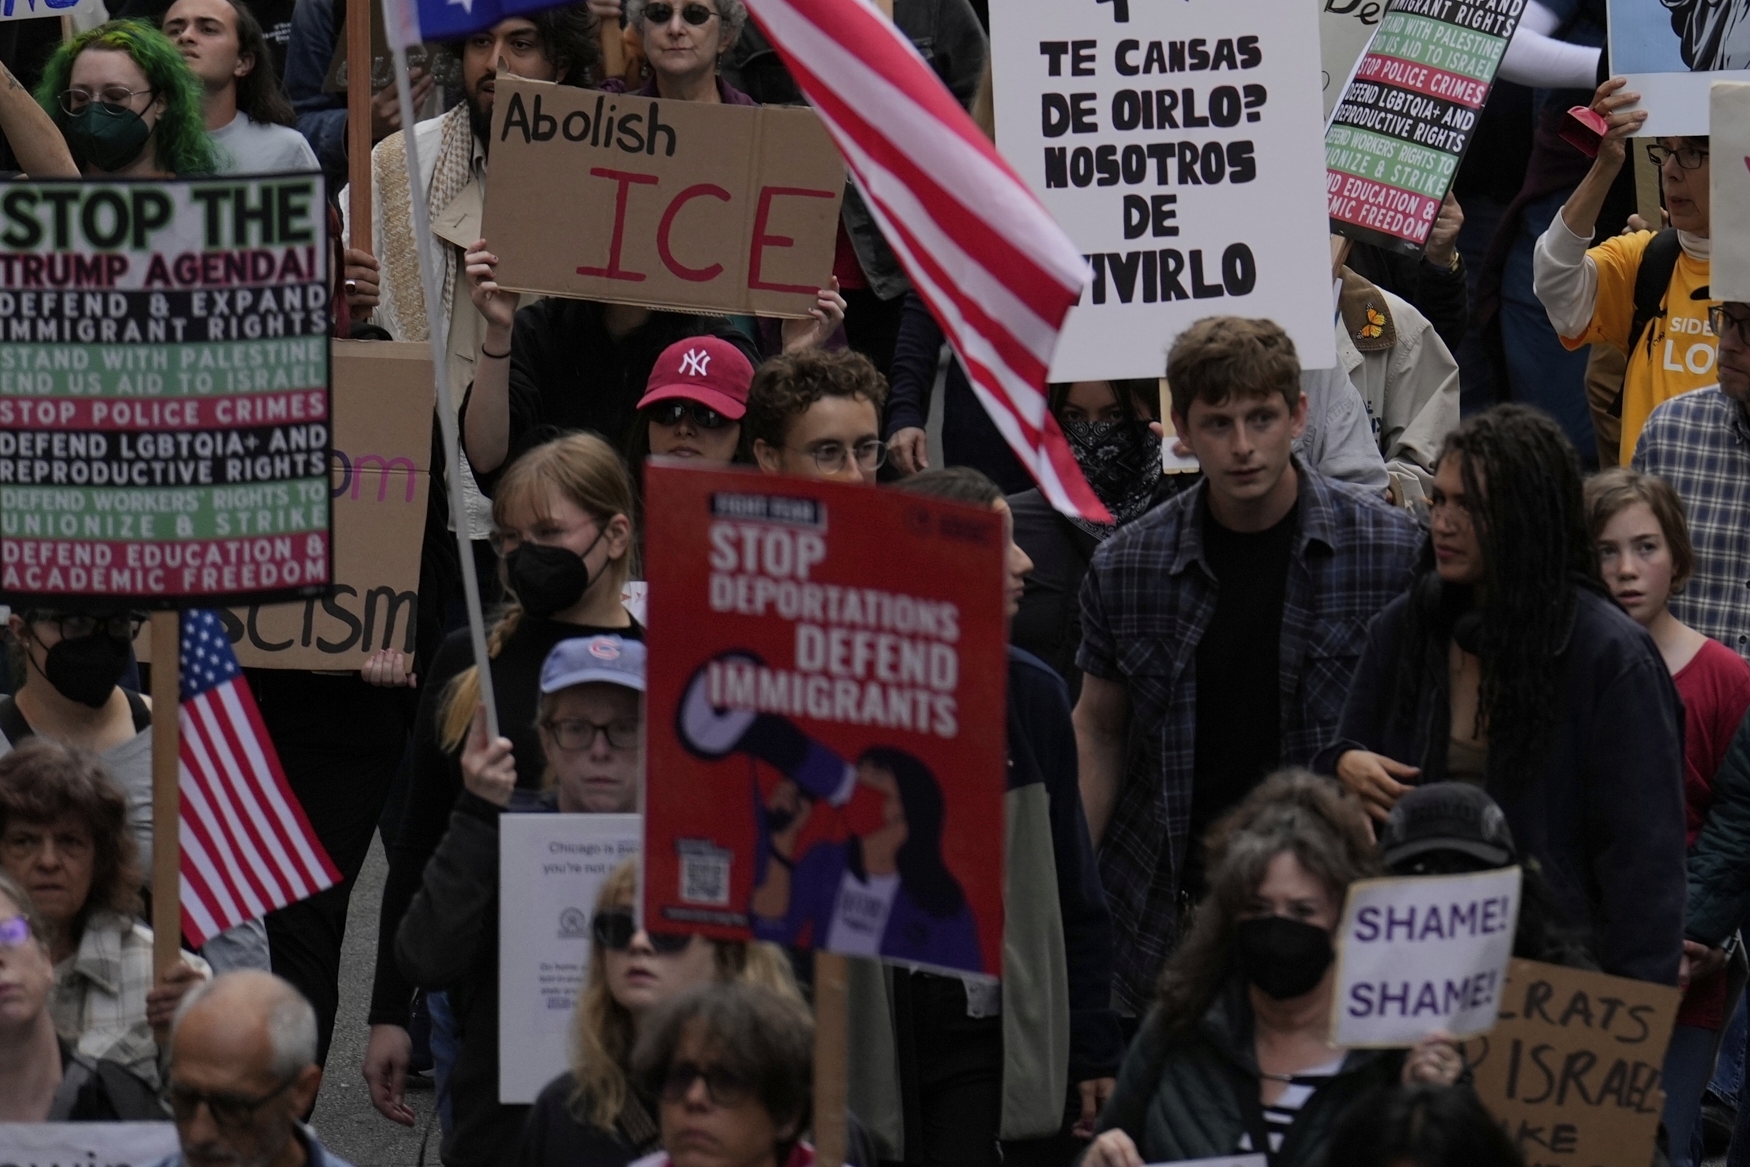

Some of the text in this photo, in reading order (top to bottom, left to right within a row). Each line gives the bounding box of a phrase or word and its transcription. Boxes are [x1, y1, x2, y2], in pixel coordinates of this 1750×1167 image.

[1040, 35, 1262, 76] TE CANSAS
[501, 92, 677, 157] Abolish
[1042, 84, 1267, 138] DE OIRLO?
[1044, 140, 1256, 188] NOSOTROS
[1, 183, 315, 251] STOP THE
[576, 167, 836, 295] ICE
[1123, 194, 1179, 239] DE
[0, 248, 316, 289] TRUMP AGENDA!
[679, 348, 711, 377] NY
[1353, 895, 1510, 944] SHAME!
[1347, 969, 1498, 1018] SHAME!
[1506, 1039, 1660, 1113] ISRAEL
